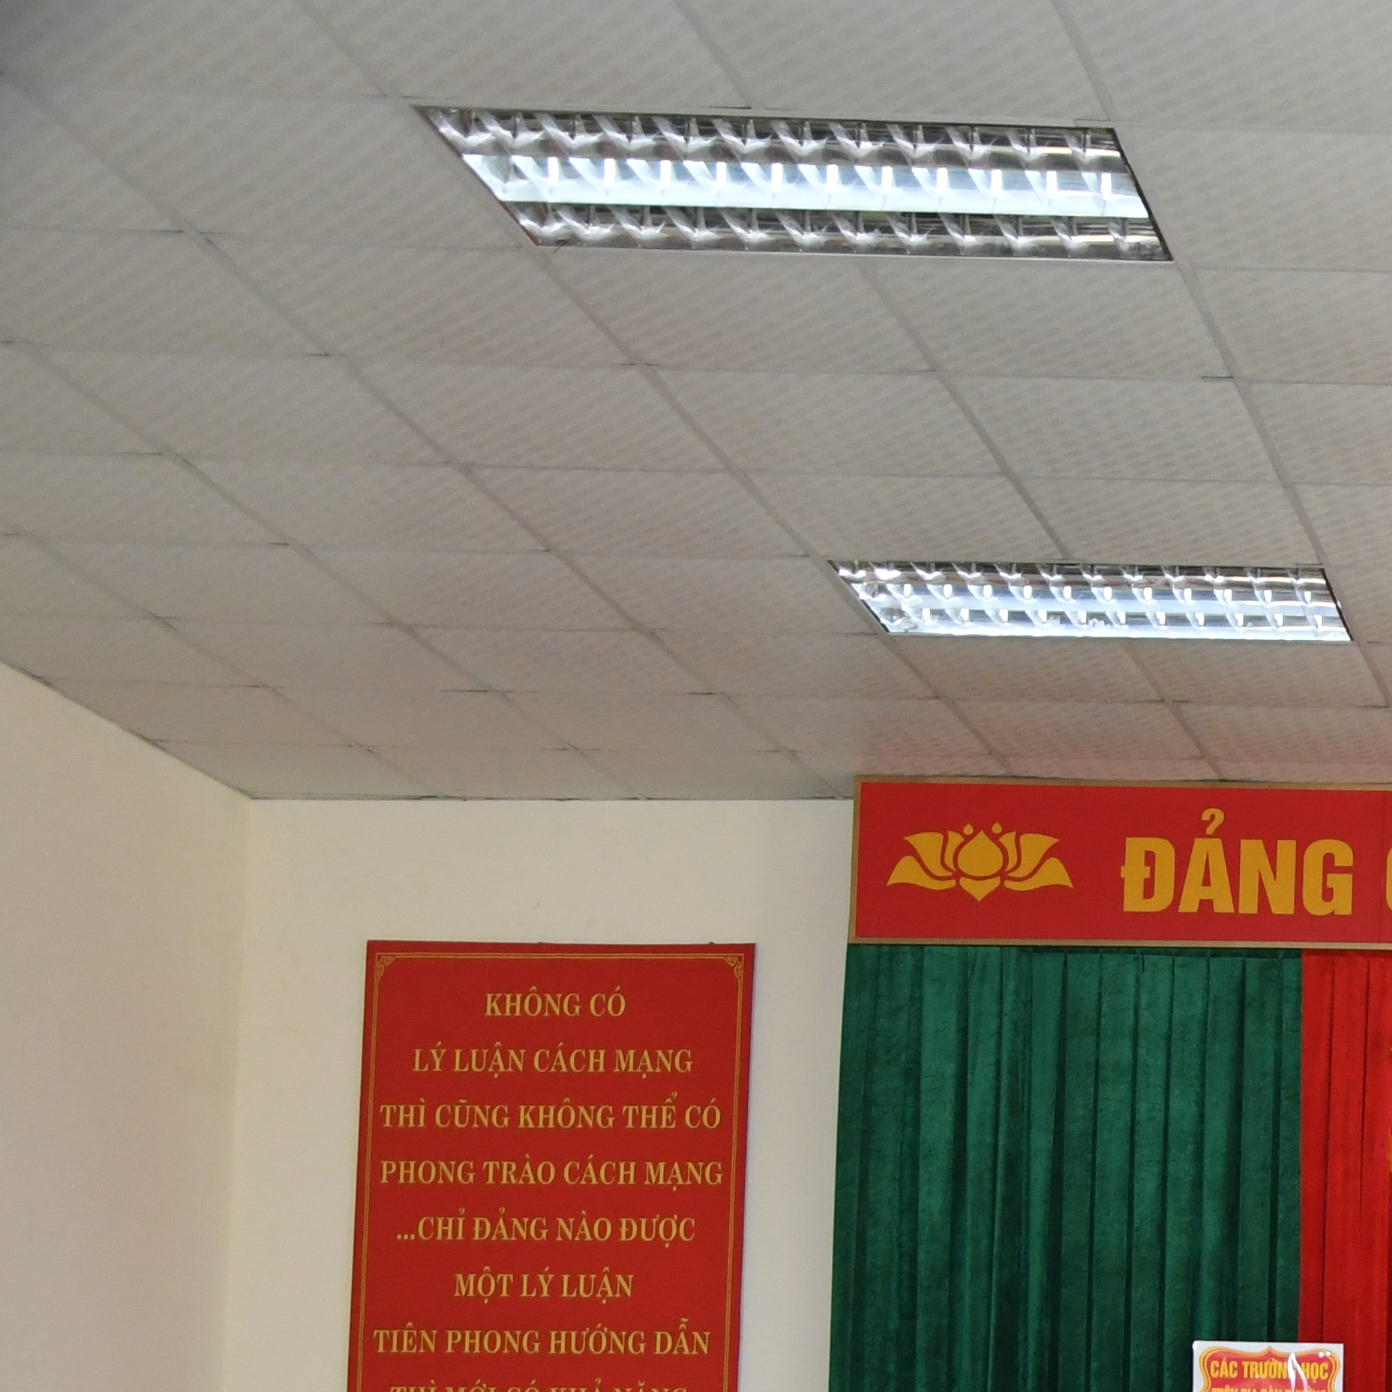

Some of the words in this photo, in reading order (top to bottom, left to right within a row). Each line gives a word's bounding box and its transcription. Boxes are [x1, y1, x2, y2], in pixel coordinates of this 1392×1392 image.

[1121, 808, 1353, 916] ĐẢNG
[485, 986, 581, 1016] KHÔNG
[590, 986, 625, 1016] CÓ
[413, 1041, 446, 1071] LÝ
[454, 1042, 526, 1078] LUẬN
[534, 1042, 606, 1072] CÁCH
[614, 1050, 692, 1079] MẠNG
[380, 1098, 425, 1128] THÌ
[435, 1099, 509, 1128] CŨNG
[518, 1098, 614, 1128] KHÔNG
[623, 1092, 677, 1128] THỂ
[685, 1098, 720, 1128] CÓ
[381, 1161, 475, 1184] PHONG
[483, 1154, 555, 1184] TRÀO
[564, 1154, 636, 1184] CÁCH
[644, 1162, 722, 1191] MẠNG
[397, 1208, 465, 1240] ...CHỈ
[473, 1208, 548, 1240] ĐẢNG
[556, 1210, 611, 1241] NÀO
[620, 1214, 695, 1248] ĐƯỢC
[454, 1266, 513, 1304] MỘT
[520, 1267, 554, 1297] LÝ
[562, 1267, 633, 1304] LUẬN
[373, 1322, 437, 1353] TIÊN
[446, 1330, 540, 1354] PHONG
[549, 1324, 646, 1354] HƯỚNG
[654, 1318, 710, 1354] DẪN
[1210, 1357, 1239, 1378] CÁC
